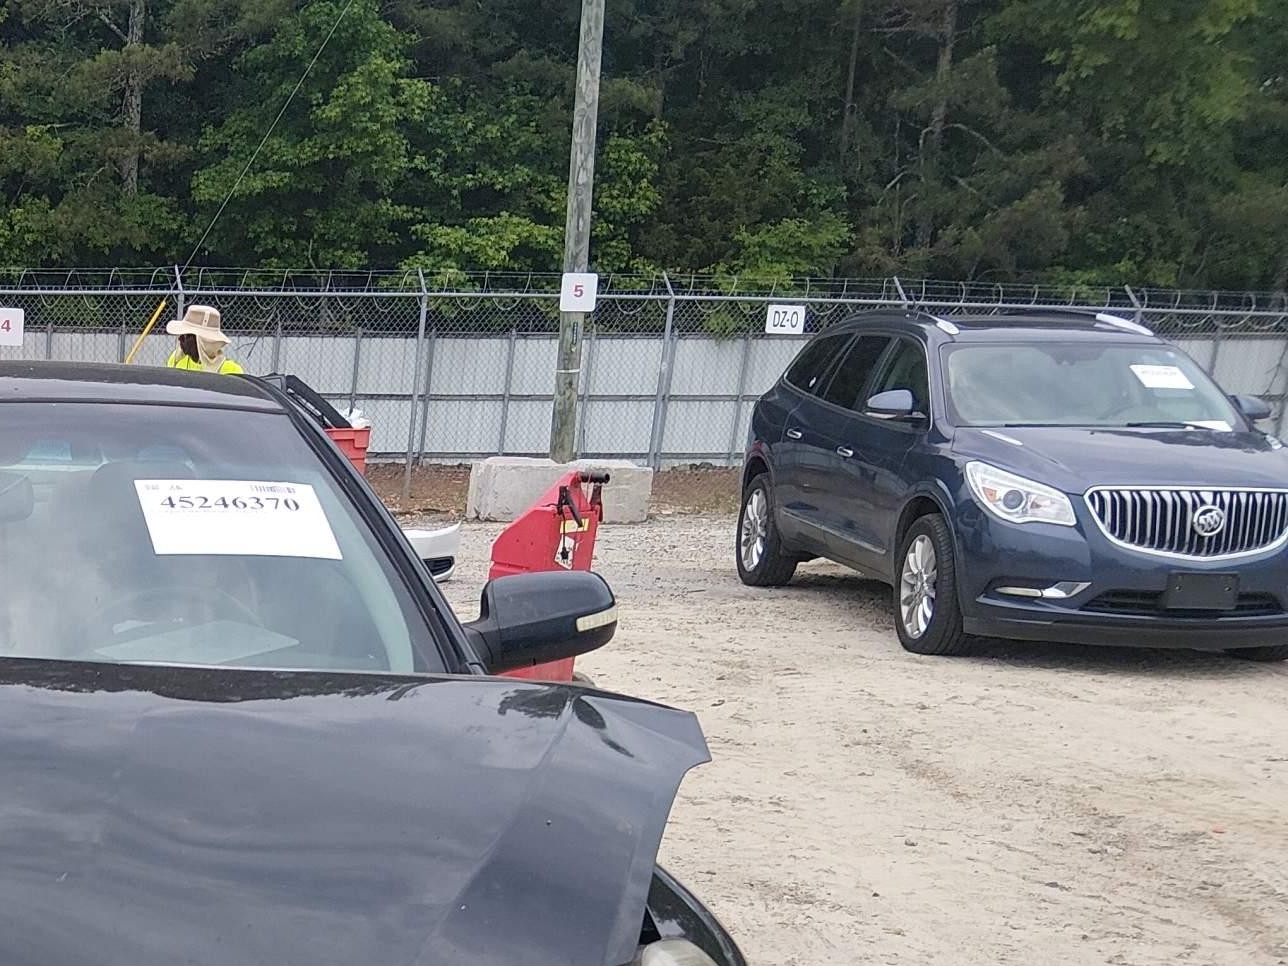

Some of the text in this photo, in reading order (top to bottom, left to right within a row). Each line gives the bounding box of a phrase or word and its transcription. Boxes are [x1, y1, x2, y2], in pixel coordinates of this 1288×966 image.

[573, 284, 584, 298] 5
[0, 319, 12, 333] 4
[160, 494, 300, 512] 45246370
